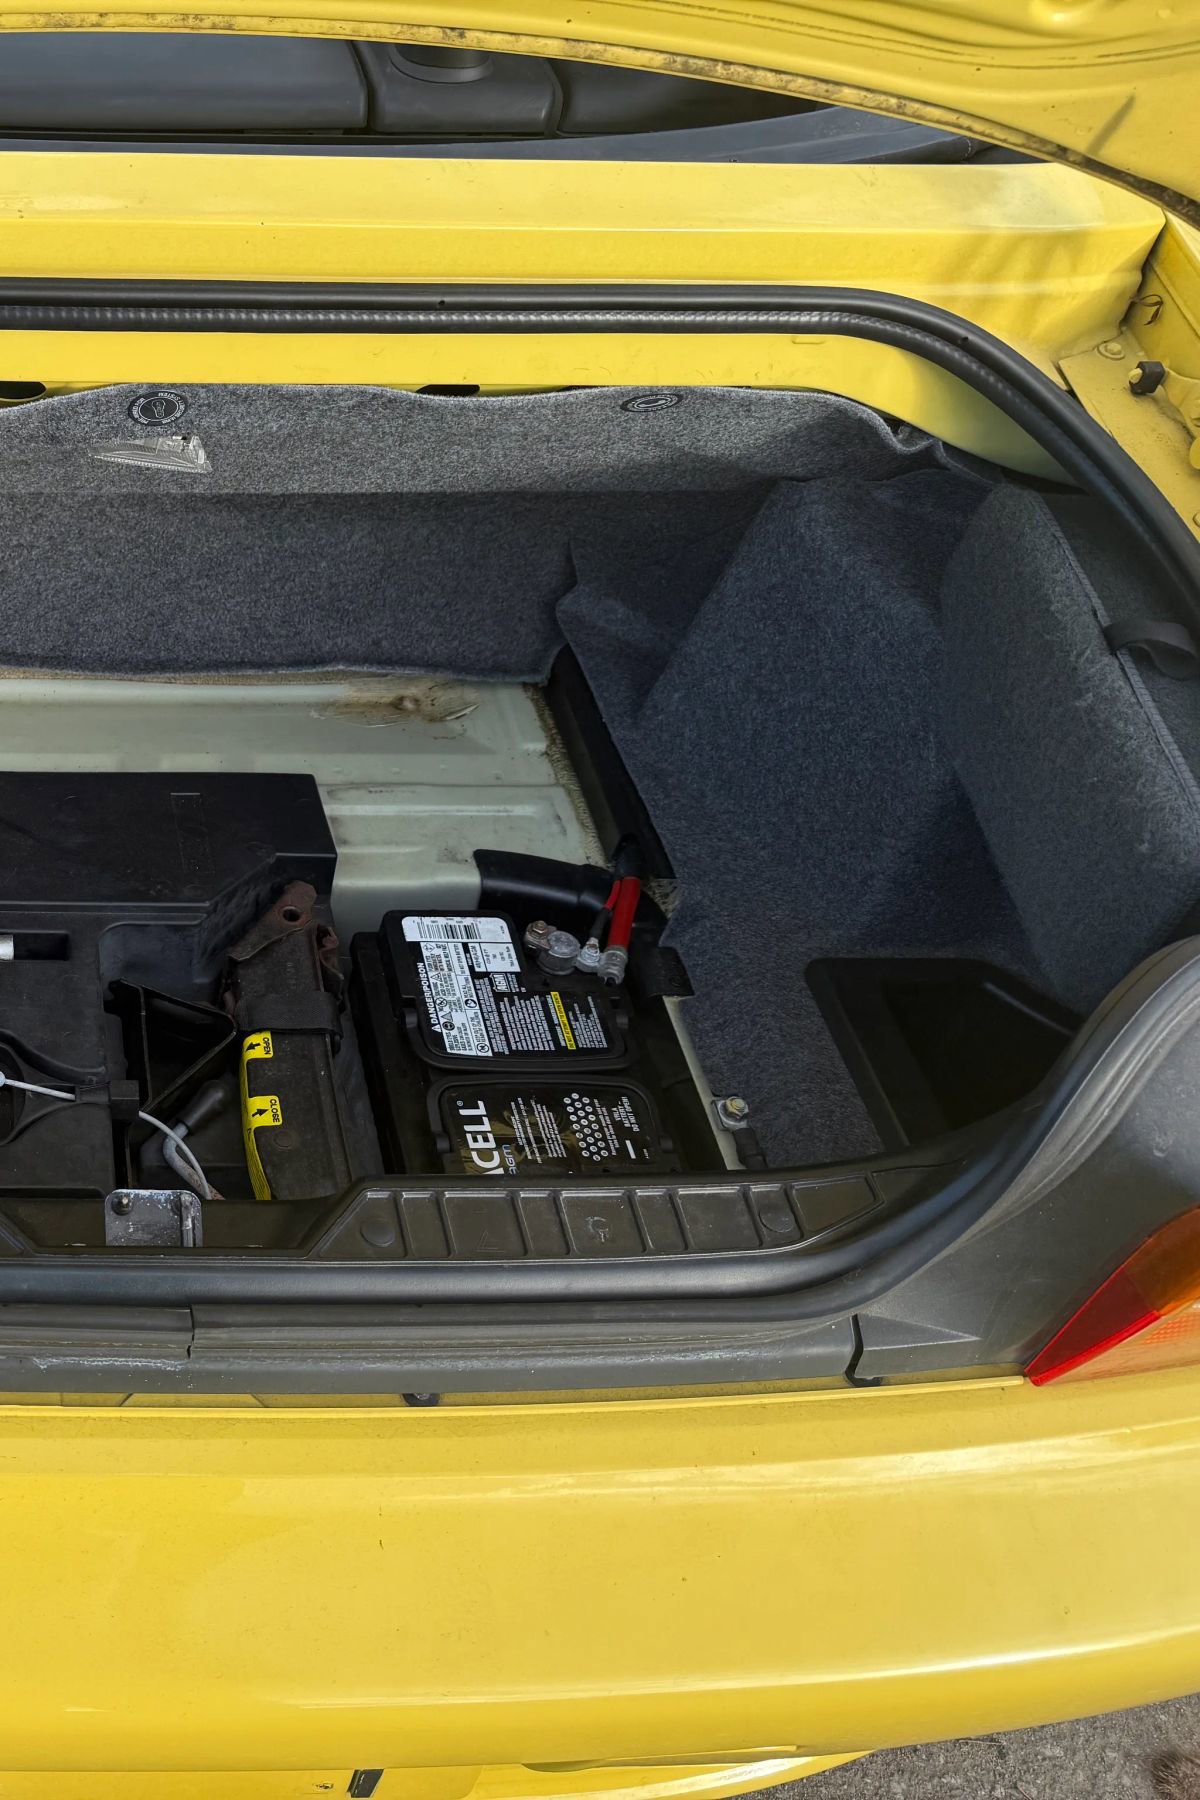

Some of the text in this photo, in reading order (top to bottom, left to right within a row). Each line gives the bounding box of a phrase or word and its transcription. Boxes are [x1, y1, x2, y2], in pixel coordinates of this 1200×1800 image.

[492, 974, 508, 990] AGM
[416, 962, 439, 1022] DANGER/POISON
[262, 1037, 271, 1055] OPEN
[269, 1099, 281, 1123] CLOSE
[617, 1105, 630, 1126] BATTERY
[626, 1113, 636, 1123] NOT
